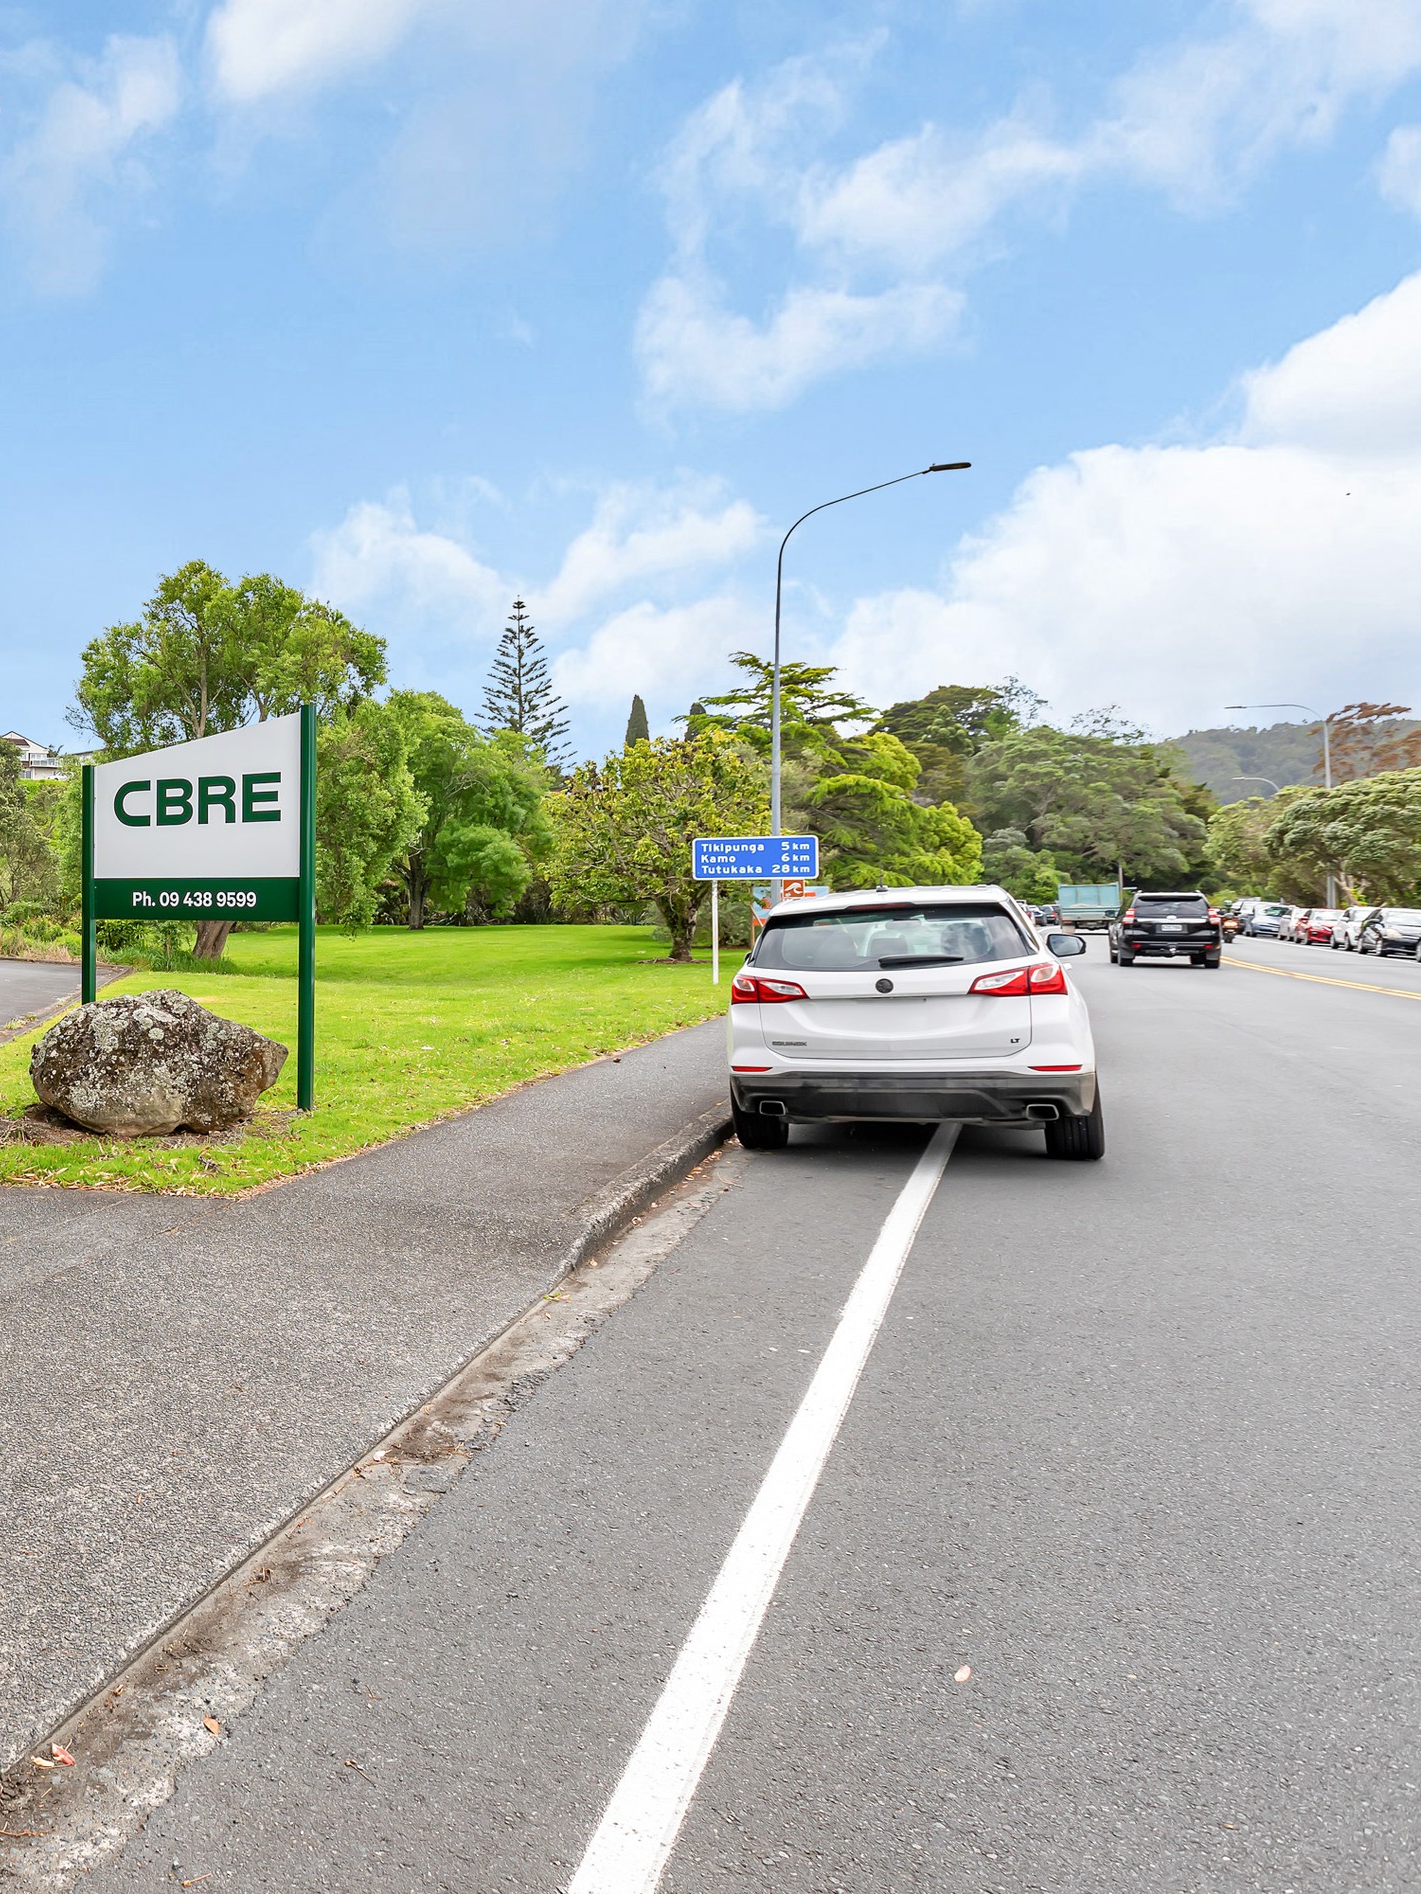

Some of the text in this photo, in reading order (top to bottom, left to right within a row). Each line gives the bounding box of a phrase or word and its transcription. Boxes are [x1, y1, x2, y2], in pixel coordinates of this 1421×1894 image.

[113, 772, 282, 827] CBRE
[701, 841, 810, 854] Tikipunga 5 km
[701, 853, 810, 863] Kamo 6 km
[701, 864, 810, 874] Tutukaka 28 km
[132, 891, 257, 907] Ph. 09 438 9599
